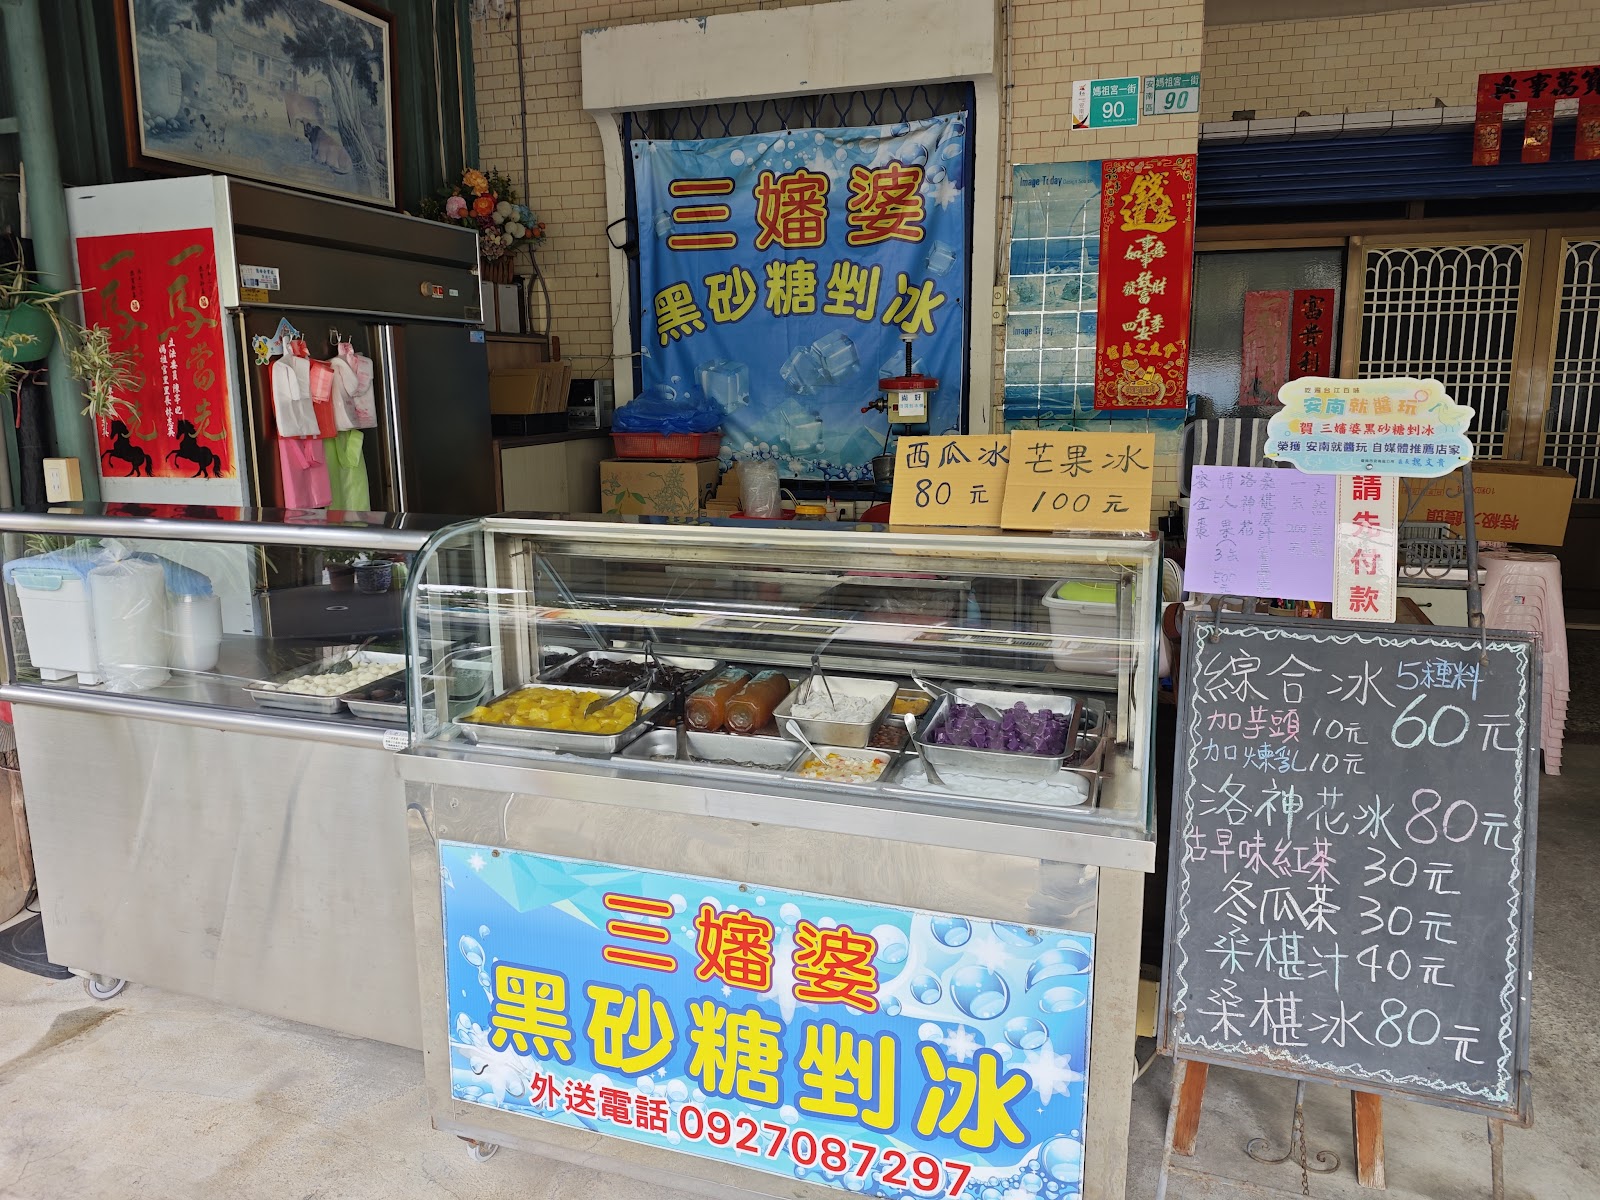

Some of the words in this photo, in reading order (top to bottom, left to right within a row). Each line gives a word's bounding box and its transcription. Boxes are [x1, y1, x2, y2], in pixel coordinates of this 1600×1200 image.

[1093, 83, 1136, 97] 媽祖宮一街
[1145, 80, 1154, 112] 安南區
[1156, 76, 1199, 87] 媽祖宮一街
[1164, 91, 1188, 110] 90
[1102, 101, 1125, 118] 90
[1020, 176, 1040, 187] Image
[667, 159, 926, 252] 三嬸婆
[652, 256, 948, 349] 黑砂糖剉冰
[1303, 396, 1418, 416] 安南就醬玩
[1277, 441, 1301, 452] 榮獲
[1306, 441, 1368, 453] 安南就醬玩
[1372, 442, 1461, 455] 自媒體推薦店家
[1300, 422, 1313, 435] 賀
[906, 440, 1010, 468] 西瓜冰
[1025, 442, 1149, 477] 芒果冰
[1426, 508, 1520, 531] 特級饅頭
[1349, 476, 1382, 613] 請先付款
[1202, 648, 1396, 707] 綜合冰
[1396, 657, 1485, 700] 5種料
[1206, 705, 1301, 743] 加芋頭
[1312, 718, 1369, 745] 10元
[1390, 693, 1518, 751] 60元
[1308, 752, 1366, 775] 10元
[1405, 788, 1514, 851] 80元
[1188, 827, 1340, 885] 古早味紅茶
[1363, 847, 1461, 895] 30元
[1213, 872, 1341, 935] 冬瓜茶
[1358, 895, 1458, 945] 30元
[602, 892, 881, 1014] 三嬸婆
[1355, 944, 1456, 988] 40元
[1374, 997, 1485, 1064] 80元
[489, 963, 1031, 1152] 黑砂糖剉冰
[530, 1071, 669, 1134] 外送電話
[679, 1106, 973, 1199] 0927087297
